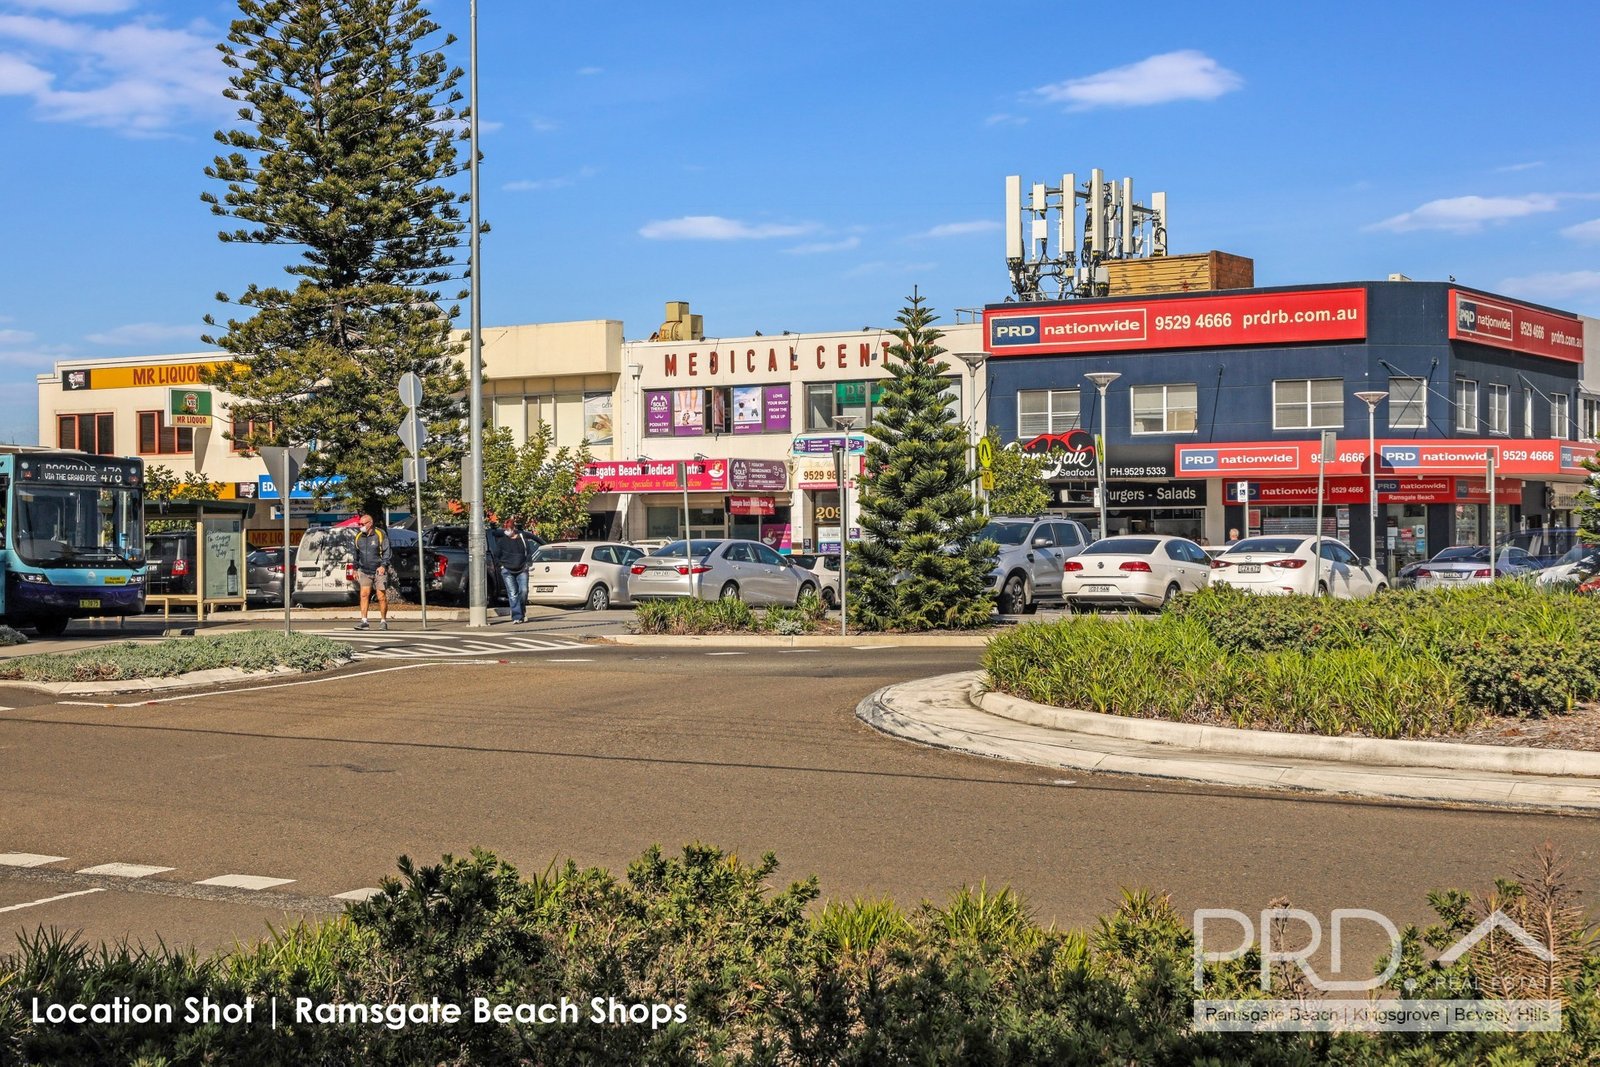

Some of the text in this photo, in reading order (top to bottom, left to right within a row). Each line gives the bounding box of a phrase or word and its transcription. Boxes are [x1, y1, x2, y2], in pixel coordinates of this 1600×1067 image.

[997, 307, 1357, 338] PRD nationwide 9529 4666 prdrb.com.au
[1459, 308, 1475, 324] PRD
[1477, 315, 1511, 331] nationwide
[1520, 321, 1532, 336] 9529
[1533, 325, 1544, 339] 4666
[664, 340, 935, 377] MEDICAL CENT
[133, 369, 155, 385] MR
[177, 416, 207, 424] MR LIQUOR
[1185, 452, 1365, 464] PRD nationwide 95 4666
[1386, 450, 1554, 461] PRD nationwid 9529 4666
[619, 465, 641, 476] Beach
[804, 471, 824, 480] 9529
[1060, 467, 1166, 477] Seafood PH.9529 5333
[56, 473, 66, 481] THE
[67, 474, 86, 482] GRAND
[1331, 486, 1347, 494] 9529
[1400, 482, 1446, 490] nationwide
[1106, 489, 1145, 502] urgers
[1157, 487, 1196, 499] Salads
[252, 530, 300, 544] MR LIQOR
